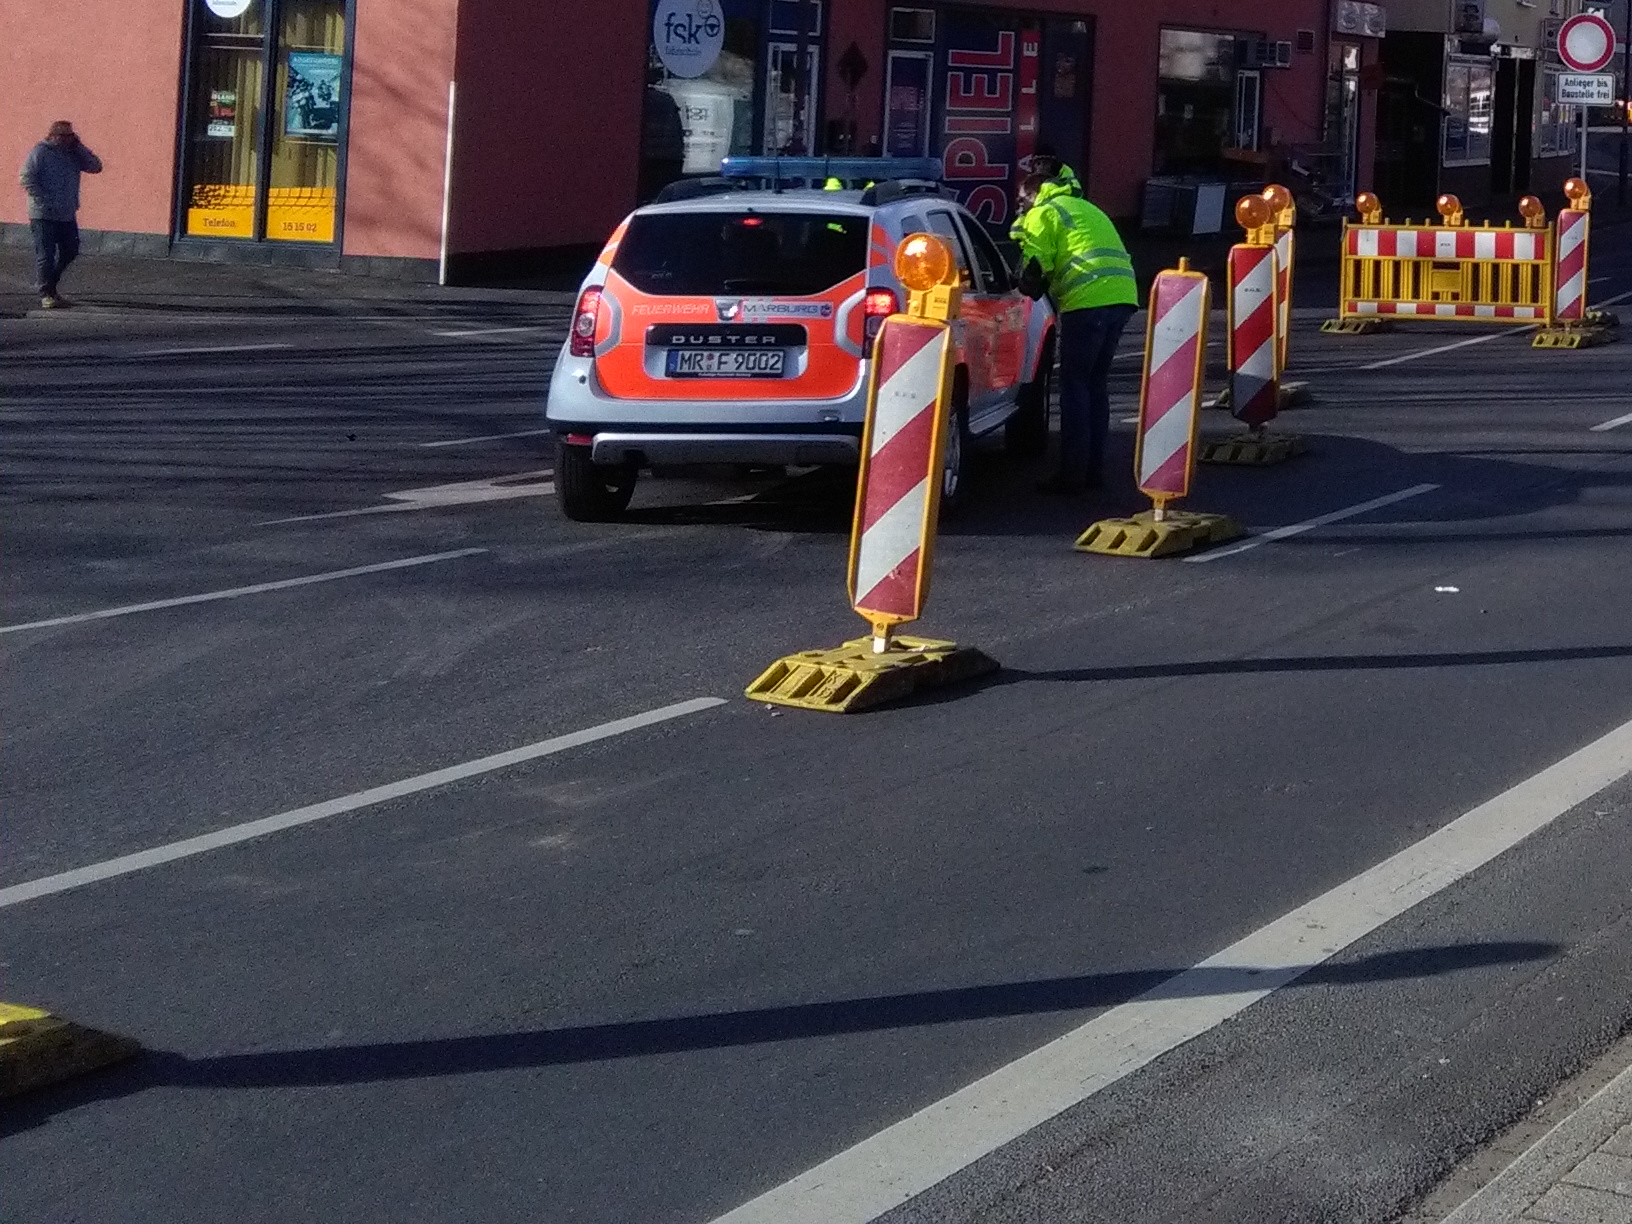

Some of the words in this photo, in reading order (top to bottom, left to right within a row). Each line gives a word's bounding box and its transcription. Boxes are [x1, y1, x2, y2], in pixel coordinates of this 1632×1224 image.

[664, 12, 702, 44] fsk
[1564, 78, 1594, 89] Anlieger
[1597, 78, 1608, 87] bis
[1561, 89, 1594, 99] Baustelle
[1597, 89, 1610, 99] frei
[943, 30, 1015, 225] SPIEL
[631, 304, 710, 315] FEUERWEHR
[743, 304, 819, 314] MARBURG
[672, 334, 776, 344] DUSTER
[679, 350, 703, 371] MR
[717, 350, 729, 370] F
[735, 349, 781, 372] 9002
